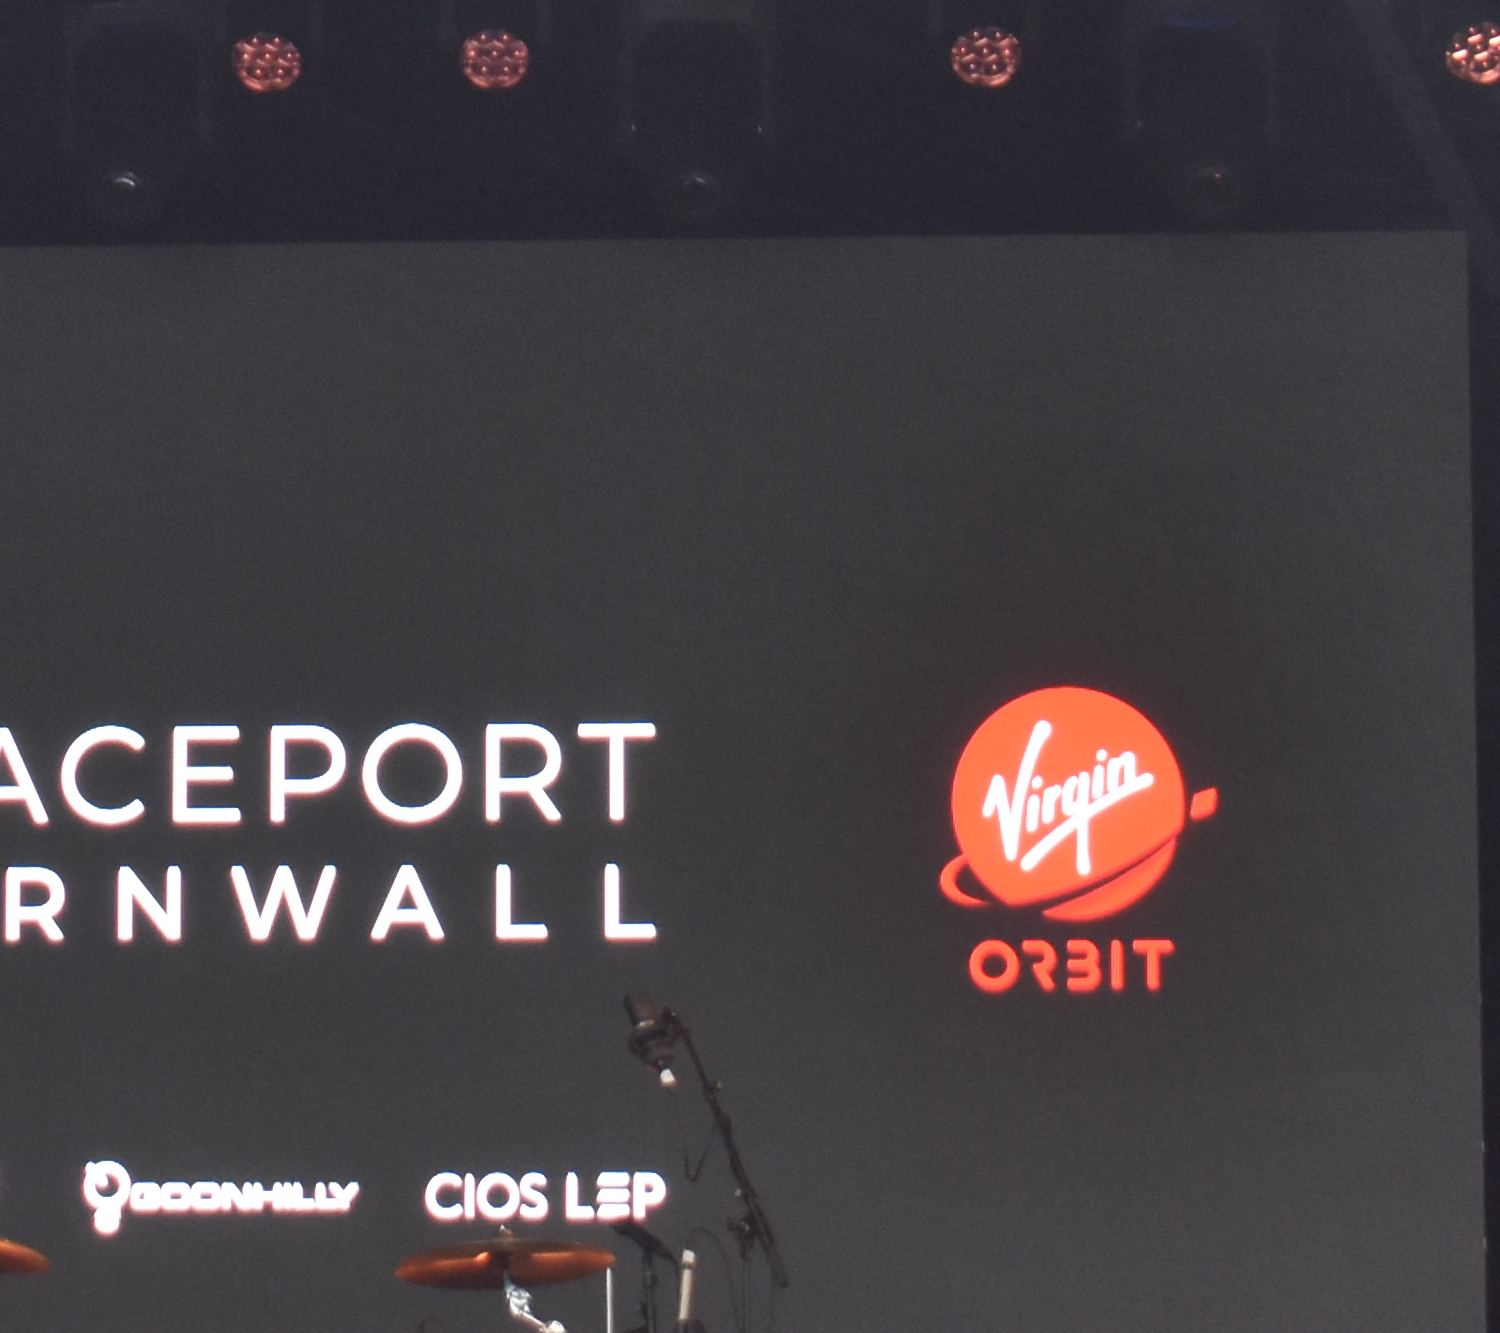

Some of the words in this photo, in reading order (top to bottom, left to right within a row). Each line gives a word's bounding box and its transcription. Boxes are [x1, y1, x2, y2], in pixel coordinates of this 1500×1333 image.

[981, 719, 1155, 876] Virgin
[968, 938, 1175, 994] ORBIT
[129, 1180, 360, 1214] GOONHILLY
[424, 1171, 549, 1221] CIOS
[565, 1170, 667, 1221] LEP
